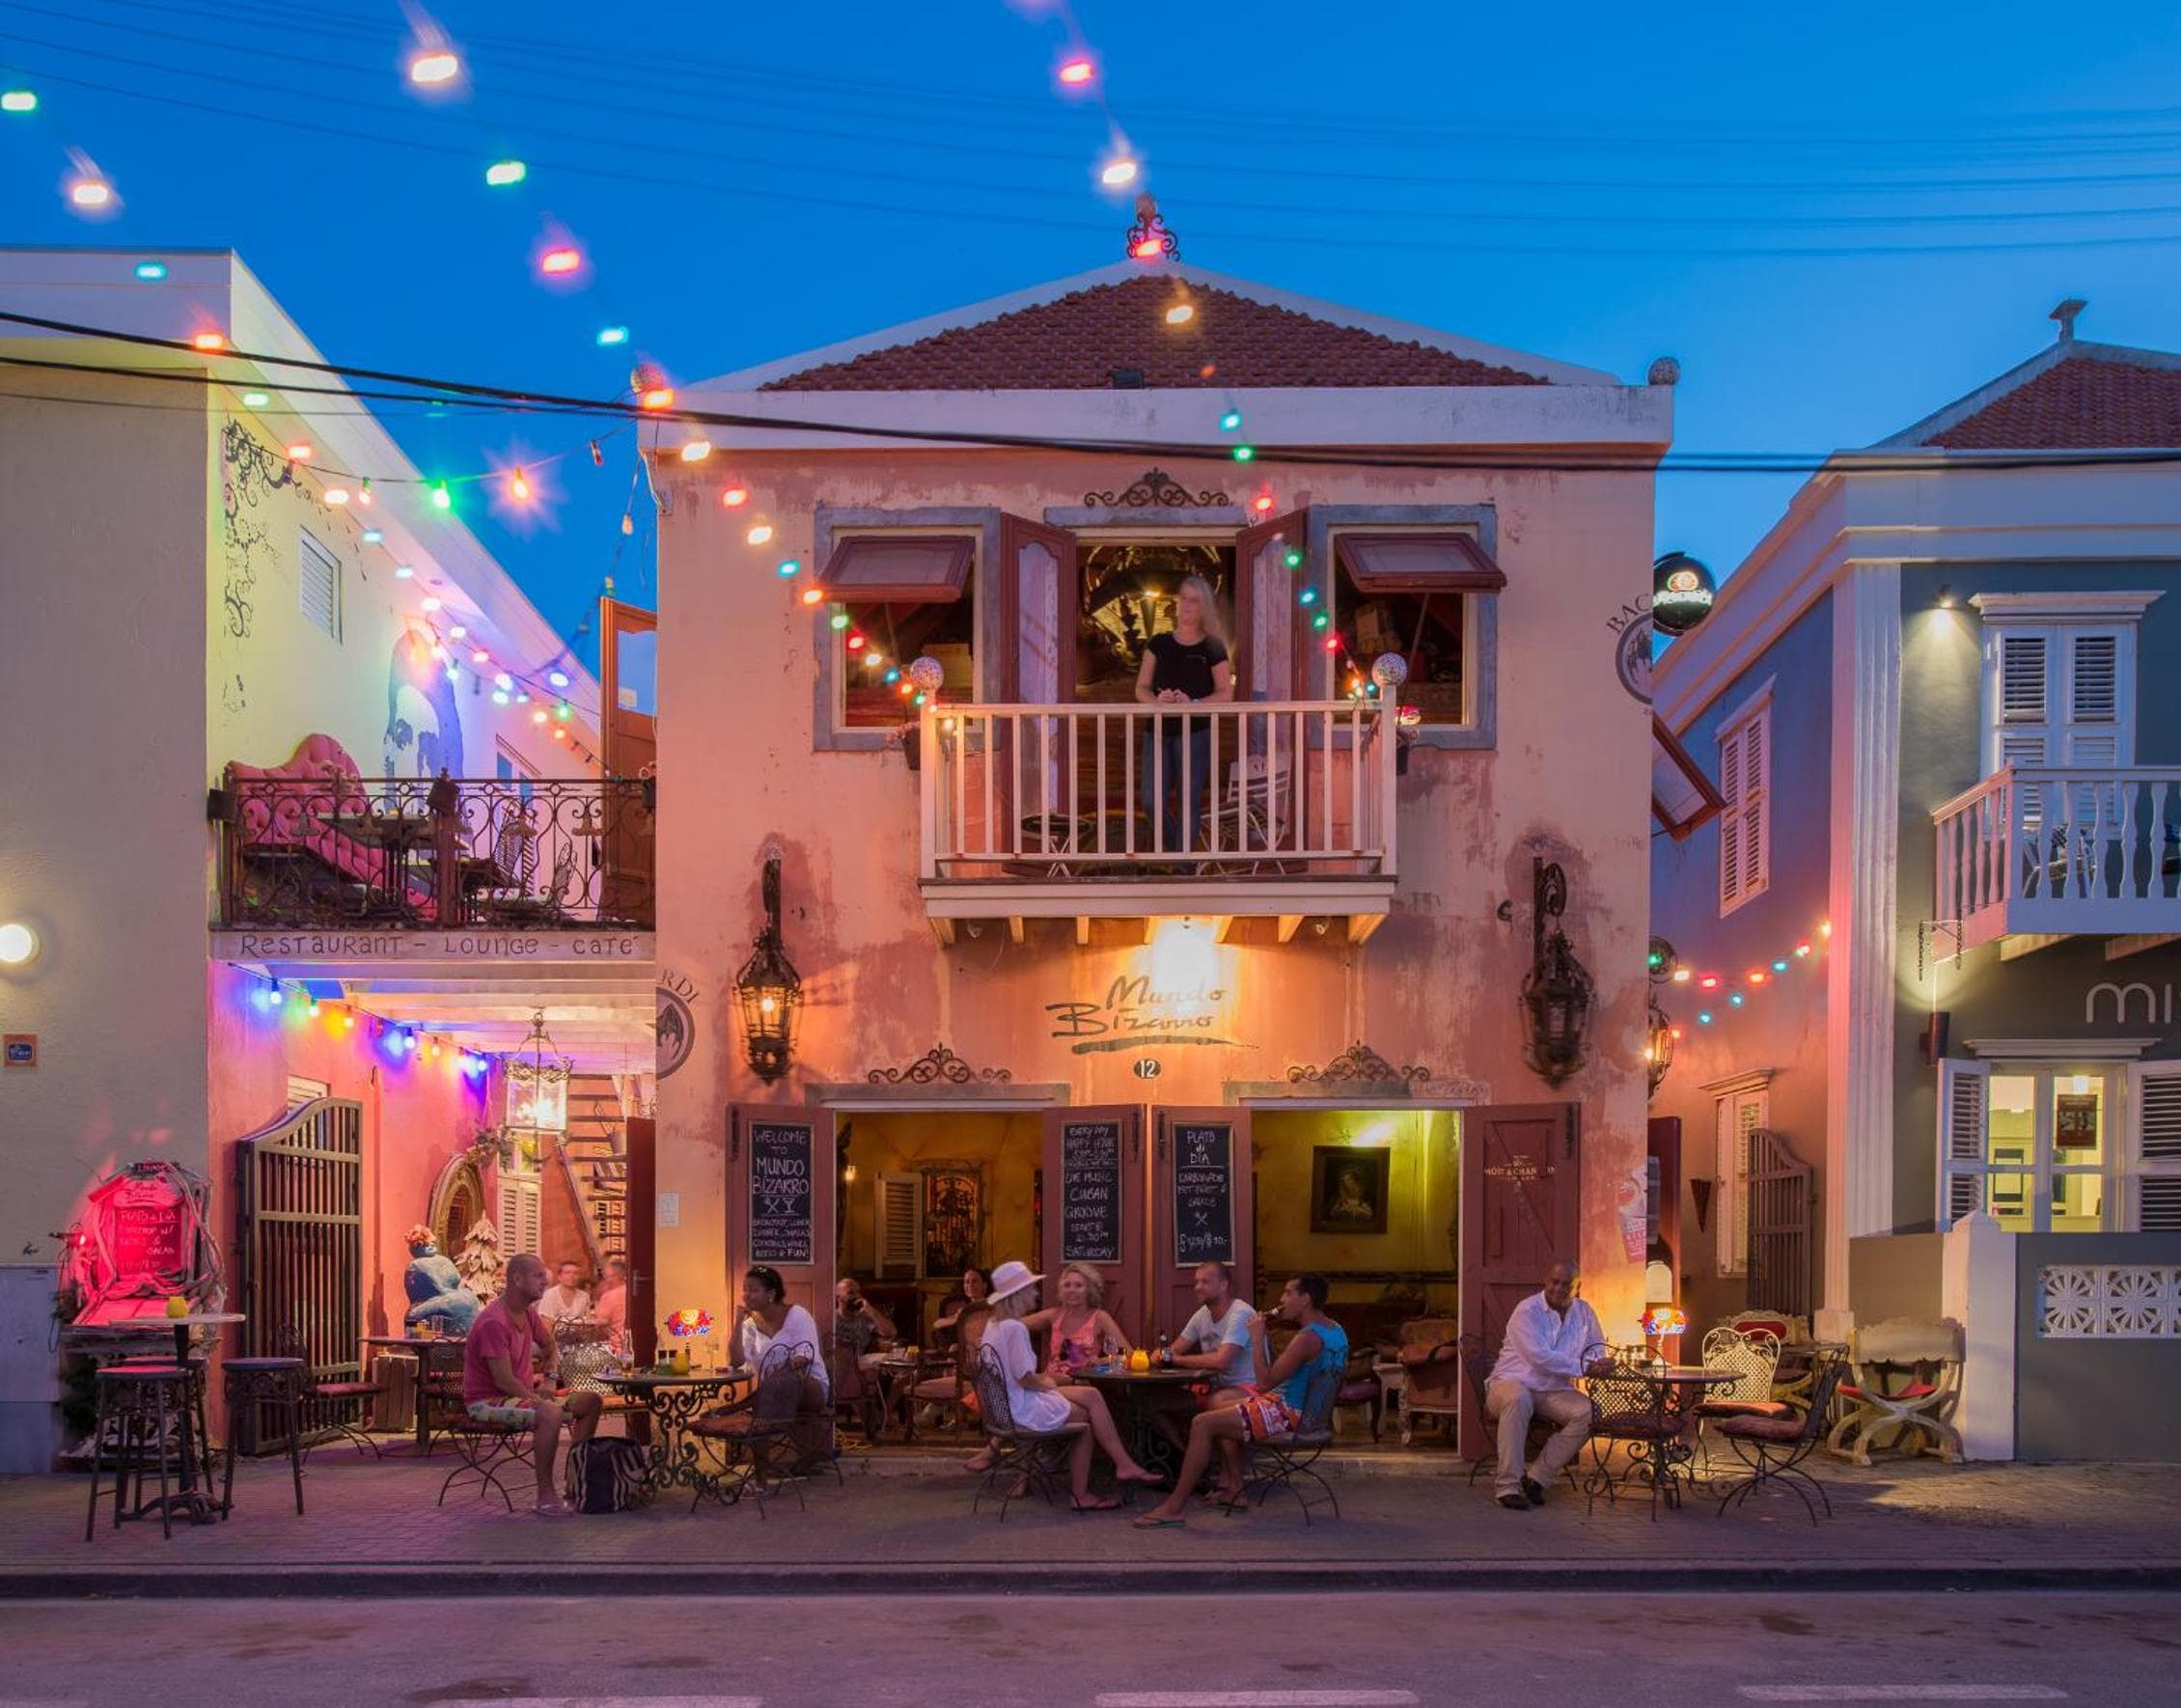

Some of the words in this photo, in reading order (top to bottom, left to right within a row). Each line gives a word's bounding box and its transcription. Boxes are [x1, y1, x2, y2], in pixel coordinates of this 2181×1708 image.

[656, 968, 700, 1005] RDI
[1106, 975, 1227, 1010] Mundo
[1045, 1003, 1214, 1038] Bizarro
[1140, 1061, 1155, 1077] 12
[754, 1129, 809, 1144] WELCOME
[1187, 1130, 1215, 1144] PLATO
[770, 1145, 787, 1155] TO
[756, 1157, 805, 1177] MUNDO
[753, 1175, 810, 1195] BIZARRO
[1069, 1186, 1109, 1201] CUBAN
[1065, 1205, 1109, 1220] GROOVE
